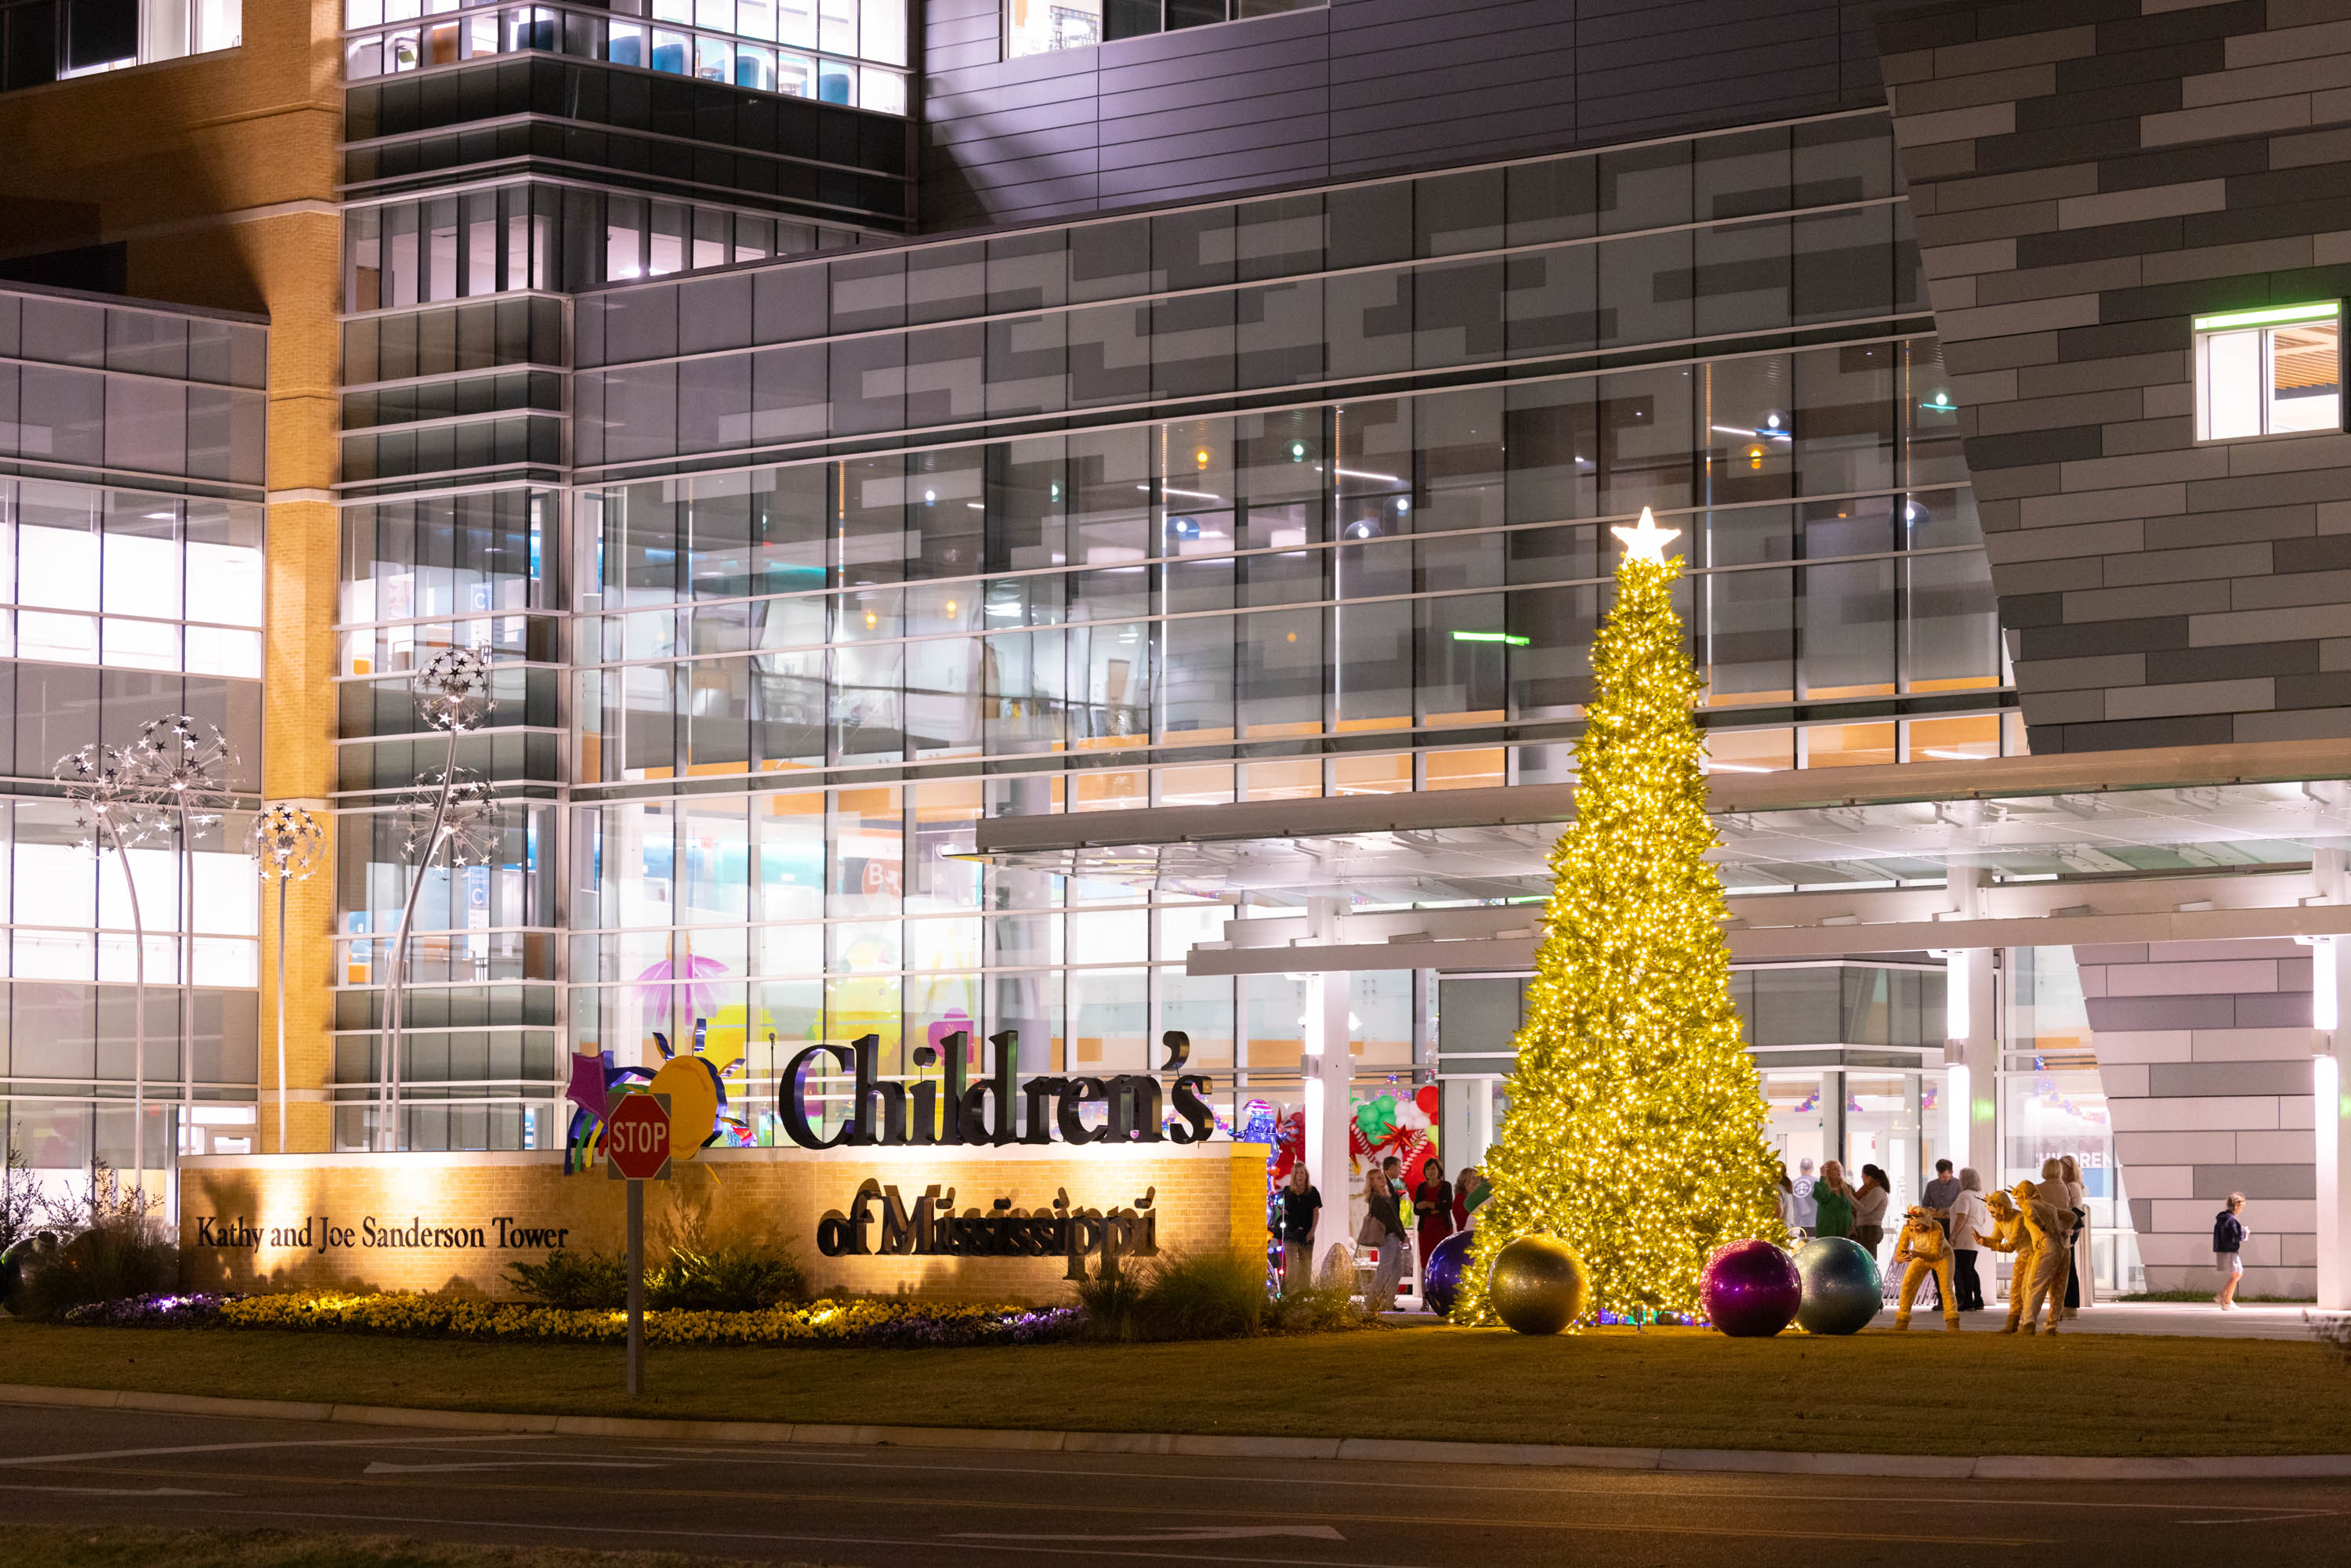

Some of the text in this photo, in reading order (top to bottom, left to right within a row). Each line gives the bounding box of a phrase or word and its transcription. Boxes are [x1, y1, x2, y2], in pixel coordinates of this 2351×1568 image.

[779, 1030, 1214, 1150] Children's
[613, 1121, 667, 1153] STOP
[197, 1216, 569, 1254] Kathy and Joe Sanderson Tower
[817, 1183, 1160, 1280] of Mississippi
